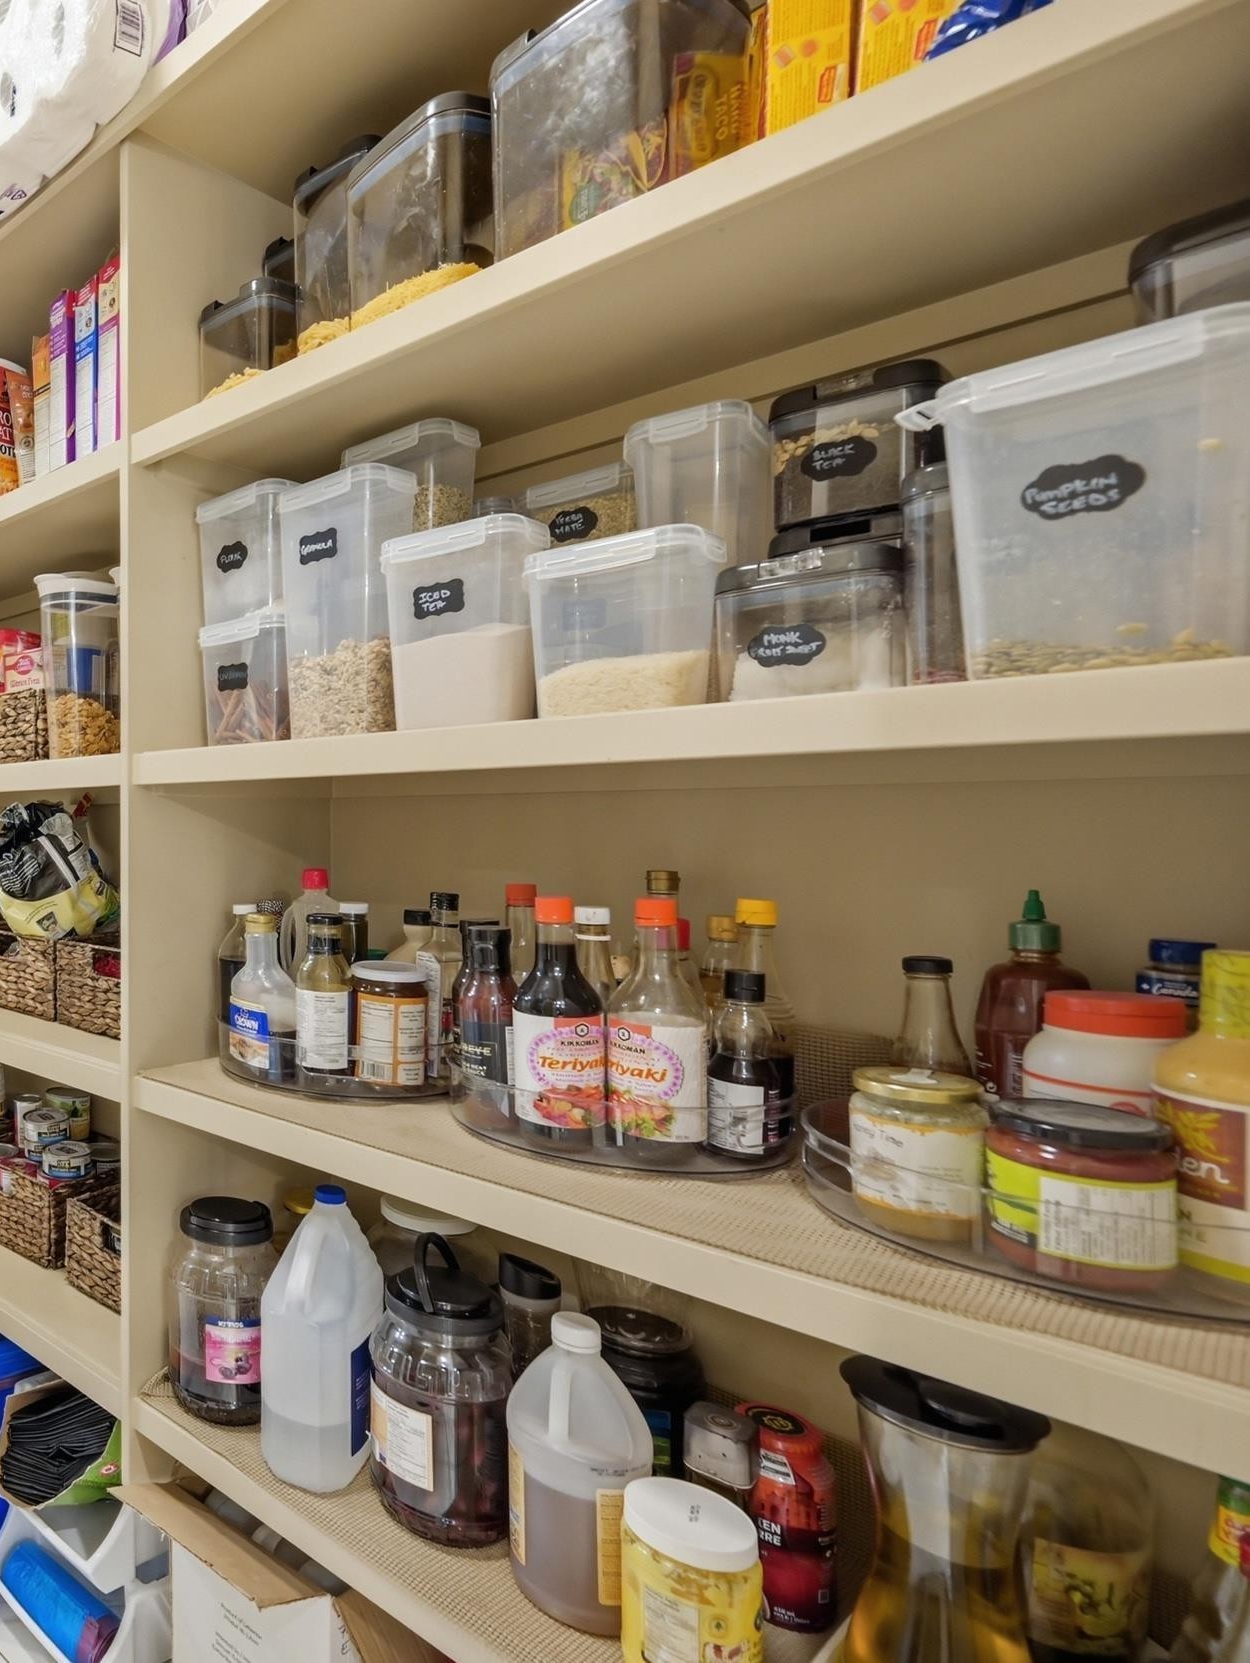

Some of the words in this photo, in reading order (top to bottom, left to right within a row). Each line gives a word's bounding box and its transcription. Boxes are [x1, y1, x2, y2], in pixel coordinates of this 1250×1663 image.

[418, 589, 451, 604] ICED
[421, 600, 447, 612] TEA
[763, 631, 804, 646] MONK
